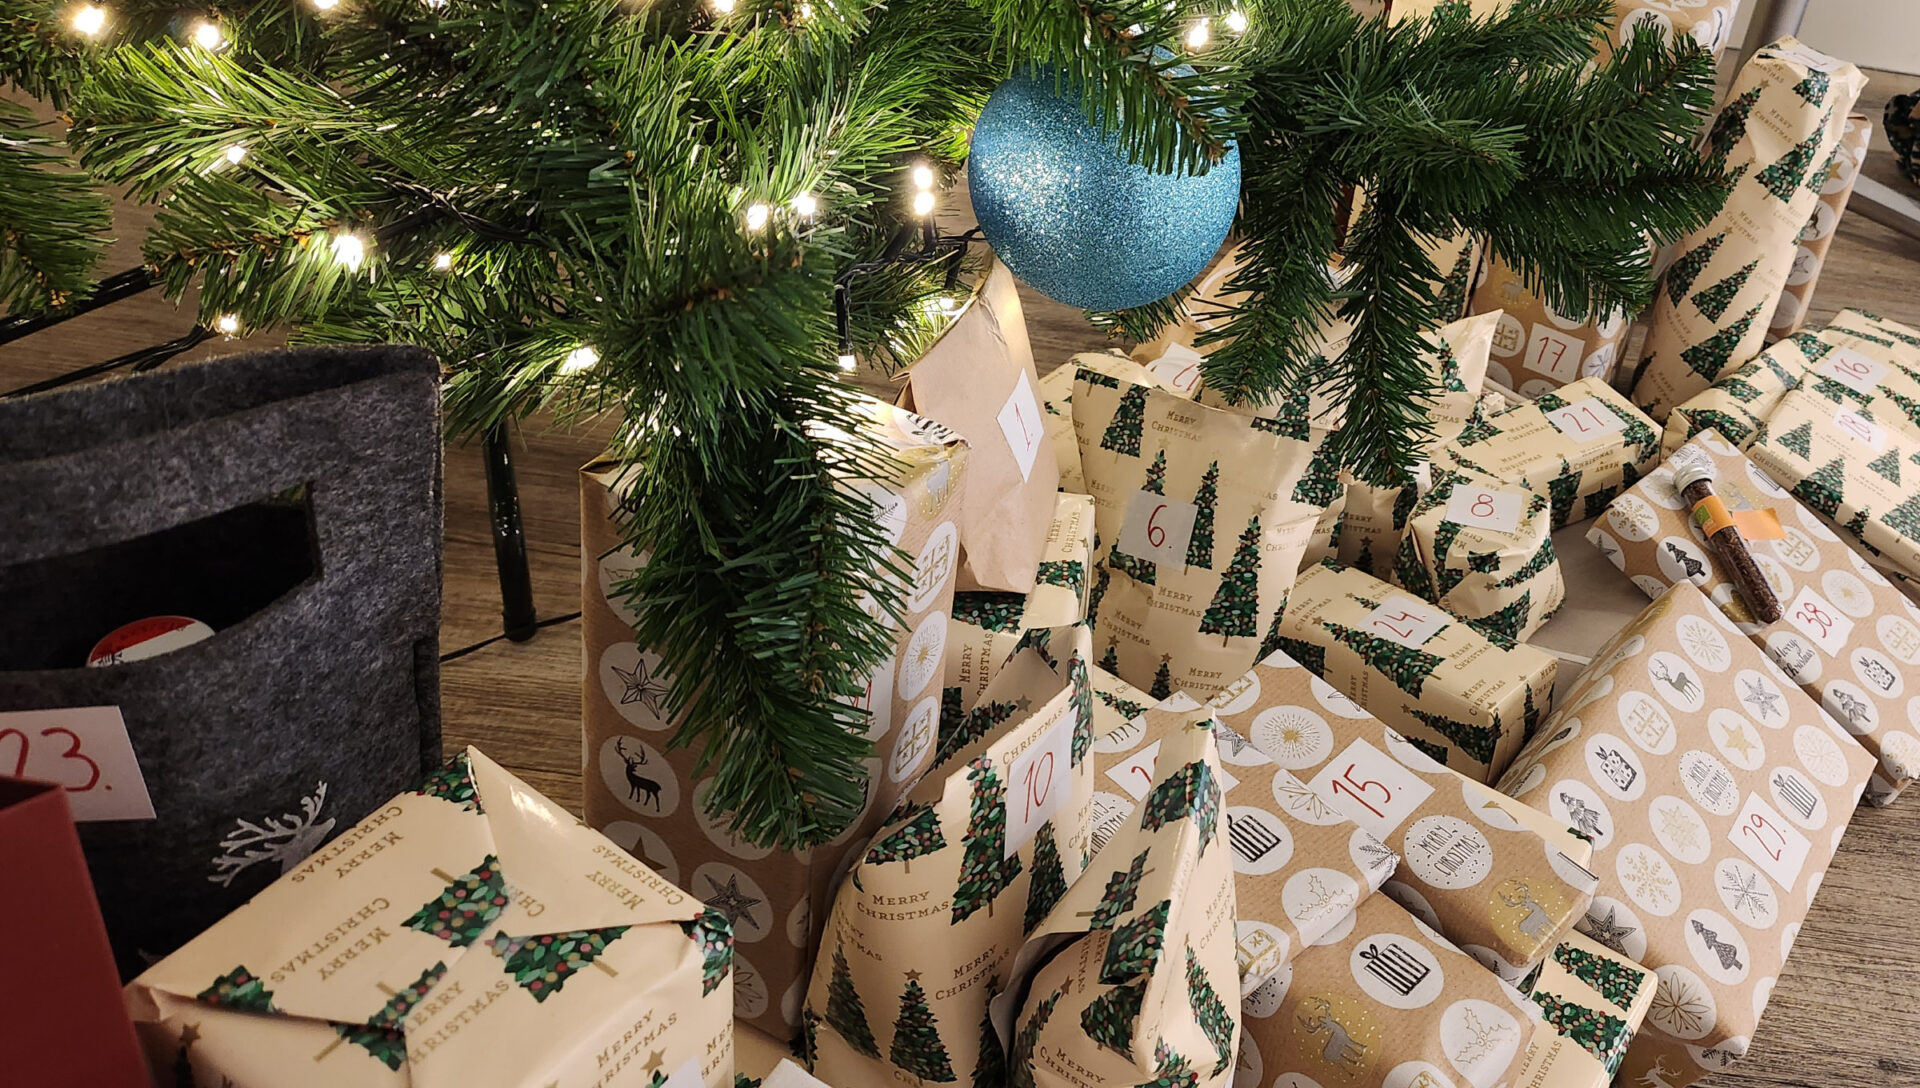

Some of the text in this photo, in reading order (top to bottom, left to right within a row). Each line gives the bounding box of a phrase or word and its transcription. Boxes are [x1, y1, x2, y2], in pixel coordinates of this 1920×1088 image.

[1755, 110, 1793, 143] CHRISTMAS
[1834, 358, 1873, 381] 16.
[1167, 410, 1197, 425] MERRY
[1753, 452, 1797, 483] CHRISTMAS
[1471, 493, 1499, 520] 8.
[1147, 504, 1172, 550] 6.
[1146, 596, 1201, 618] CHRISTMAS
[1158, 586, 1193, 602] MERRY
[1102, 616, 1150, 646] CHRISTMAS
[1115, 610, 1142, 630] MERRY
[1373, 611, 1426, 638] 24.
[1796, 602, 1839, 638] 38.
[959, 644, 973, 683] MERRY
[1449, 642, 1473, 660] MERRY
[1454, 643, 1492, 670] CHRISTMAS
[1189, 667, 1223, 679] MERRY
[1461, 679, 1487, 700] MERRY
[1468, 679, 1506, 717] CHRISTMAS
[1332, 763, 1402, 819] 15.
[291, 806, 403, 883] CHRISTMAS
[335, 831, 404, 879] MERRY
[1415, 825, 1453, 855] MERRY
[1743, 814, 1787, 861] 29.
[1433, 835, 1480, 877] CHRISTMAS
[586, 870, 646, 911] MERRY
[592, 843, 685, 906] CHRISTMAS
[857, 900, 949, 921] CHRISTMAS
[873, 891, 929, 906] MERRY
[270, 897, 391, 984] CHRISTMAS
[317, 925, 391, 982] MERRY
[936, 947, 1010, 1000] CHRISTMAS
[953, 944, 998, 979] MERRY
[408, 980, 510, 1065] HRISTMAS
[597, 1008, 653, 1068] MERRY
[1056, 1048, 1105, 1084] MERRY
